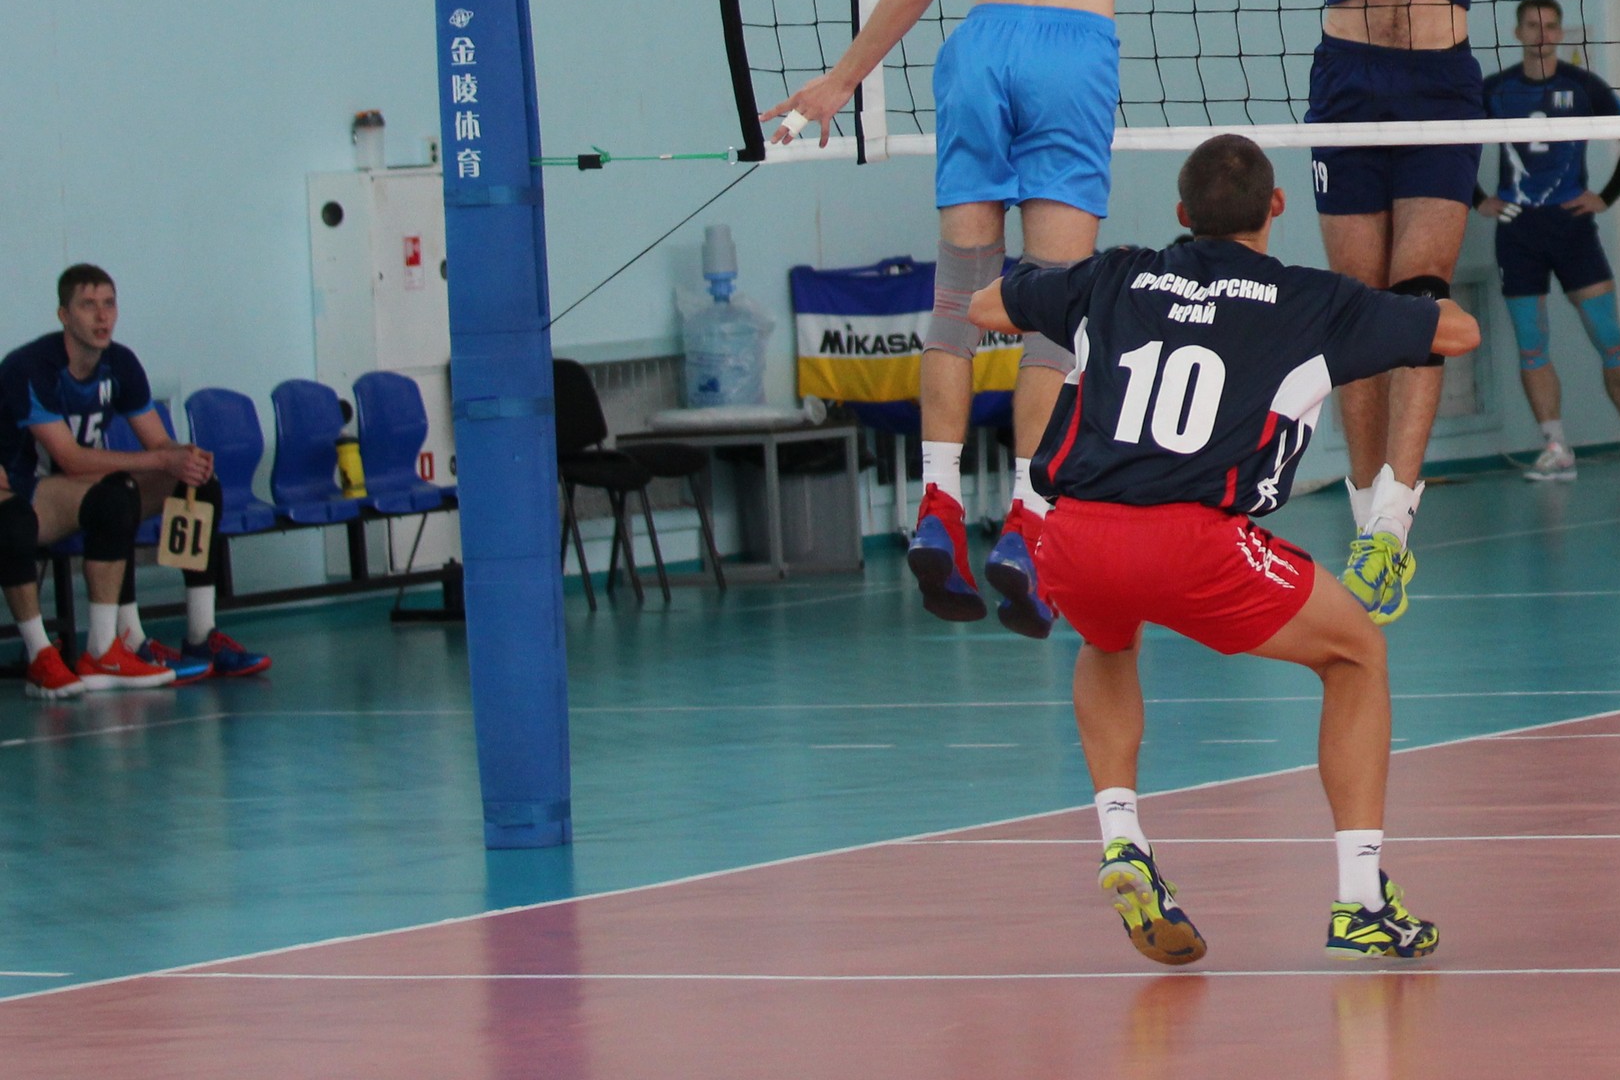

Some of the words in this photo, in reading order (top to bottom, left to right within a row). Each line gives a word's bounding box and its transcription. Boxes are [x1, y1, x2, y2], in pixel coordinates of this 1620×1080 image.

[451, 36, 482, 179] 金陵体育
[1312, 160, 1329, 194] 19
[1130, 272, 1279, 305] КРАСНОДАРСКИЙ
[1167, 301, 1217, 325] КРАЙ
[1113, 340, 1226, 455] 10
